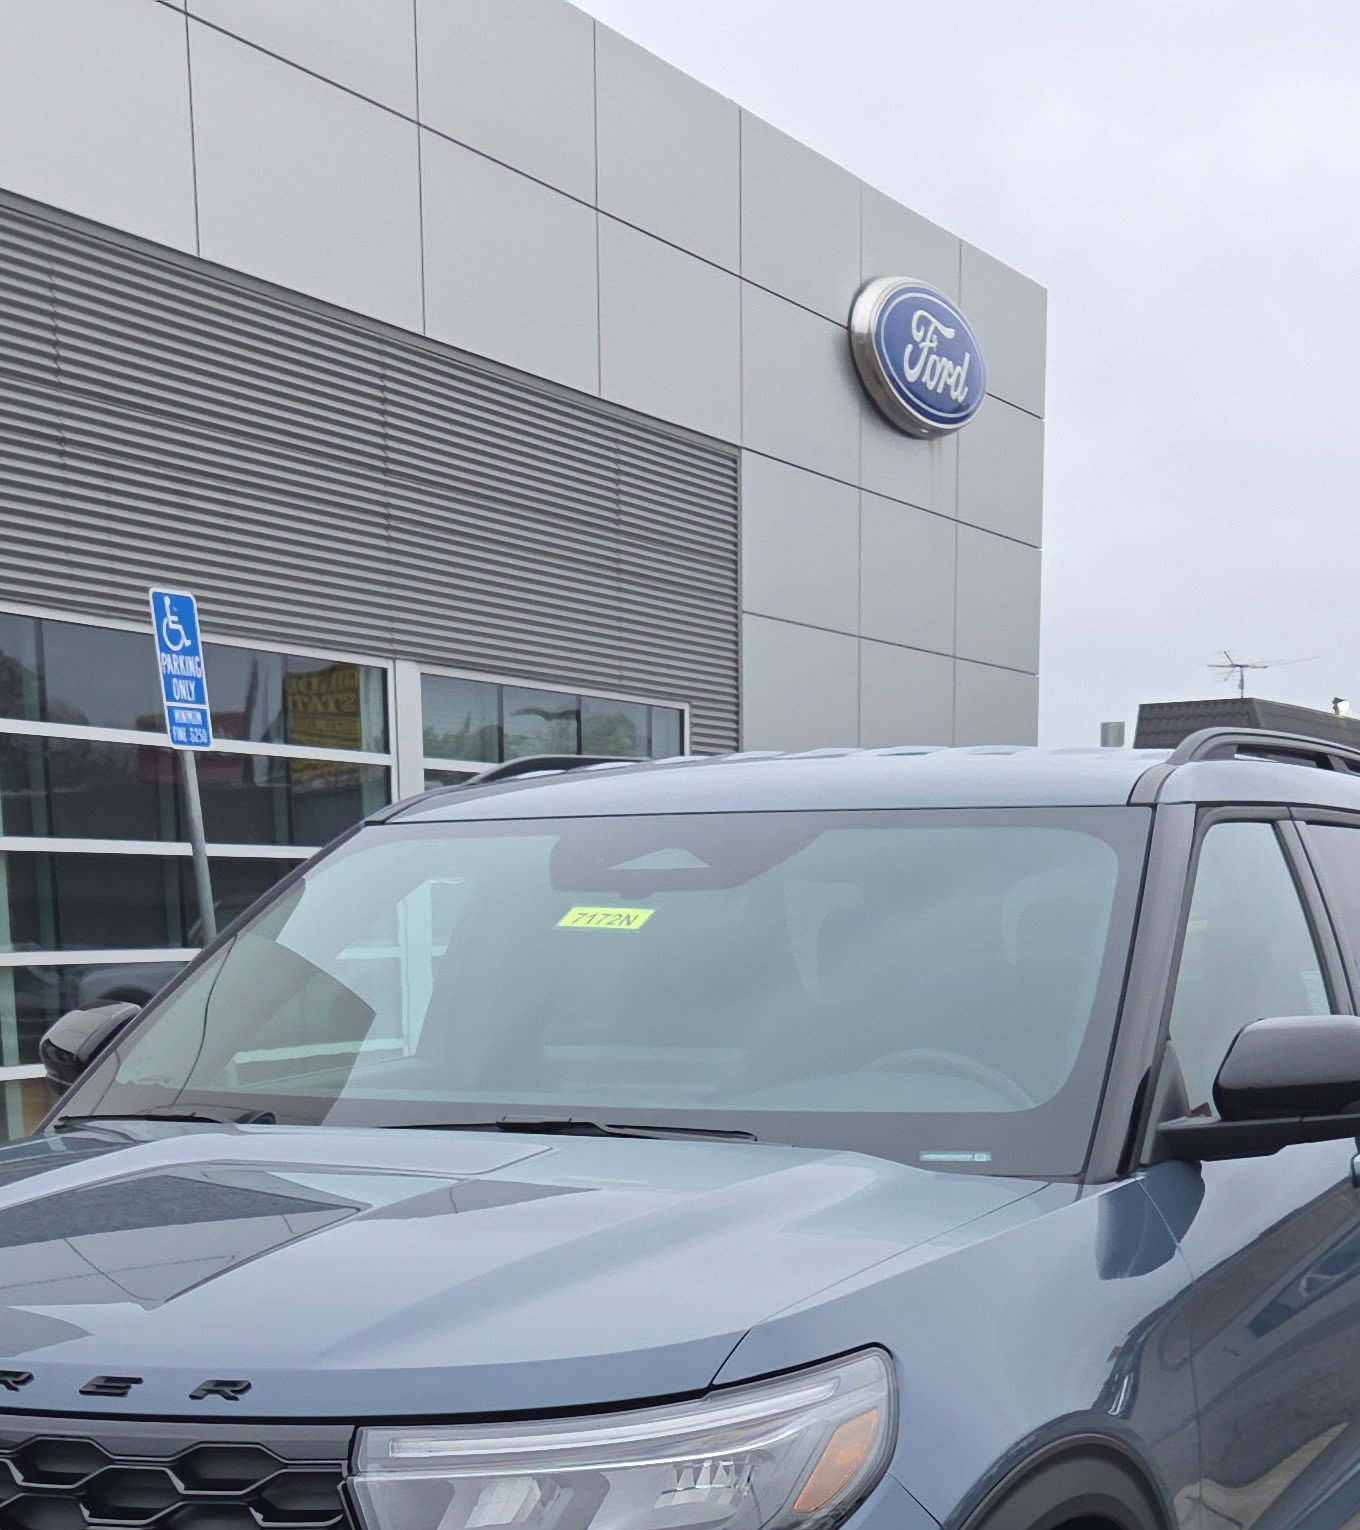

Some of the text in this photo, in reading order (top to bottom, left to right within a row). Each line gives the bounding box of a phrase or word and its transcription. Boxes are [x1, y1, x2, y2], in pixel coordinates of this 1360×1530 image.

[903, 309, 971, 404] Ford
[161, 652, 202, 678] PARKING
[172, 678, 195, 701] ONLY
[570, 912, 640, 927] 7172N
